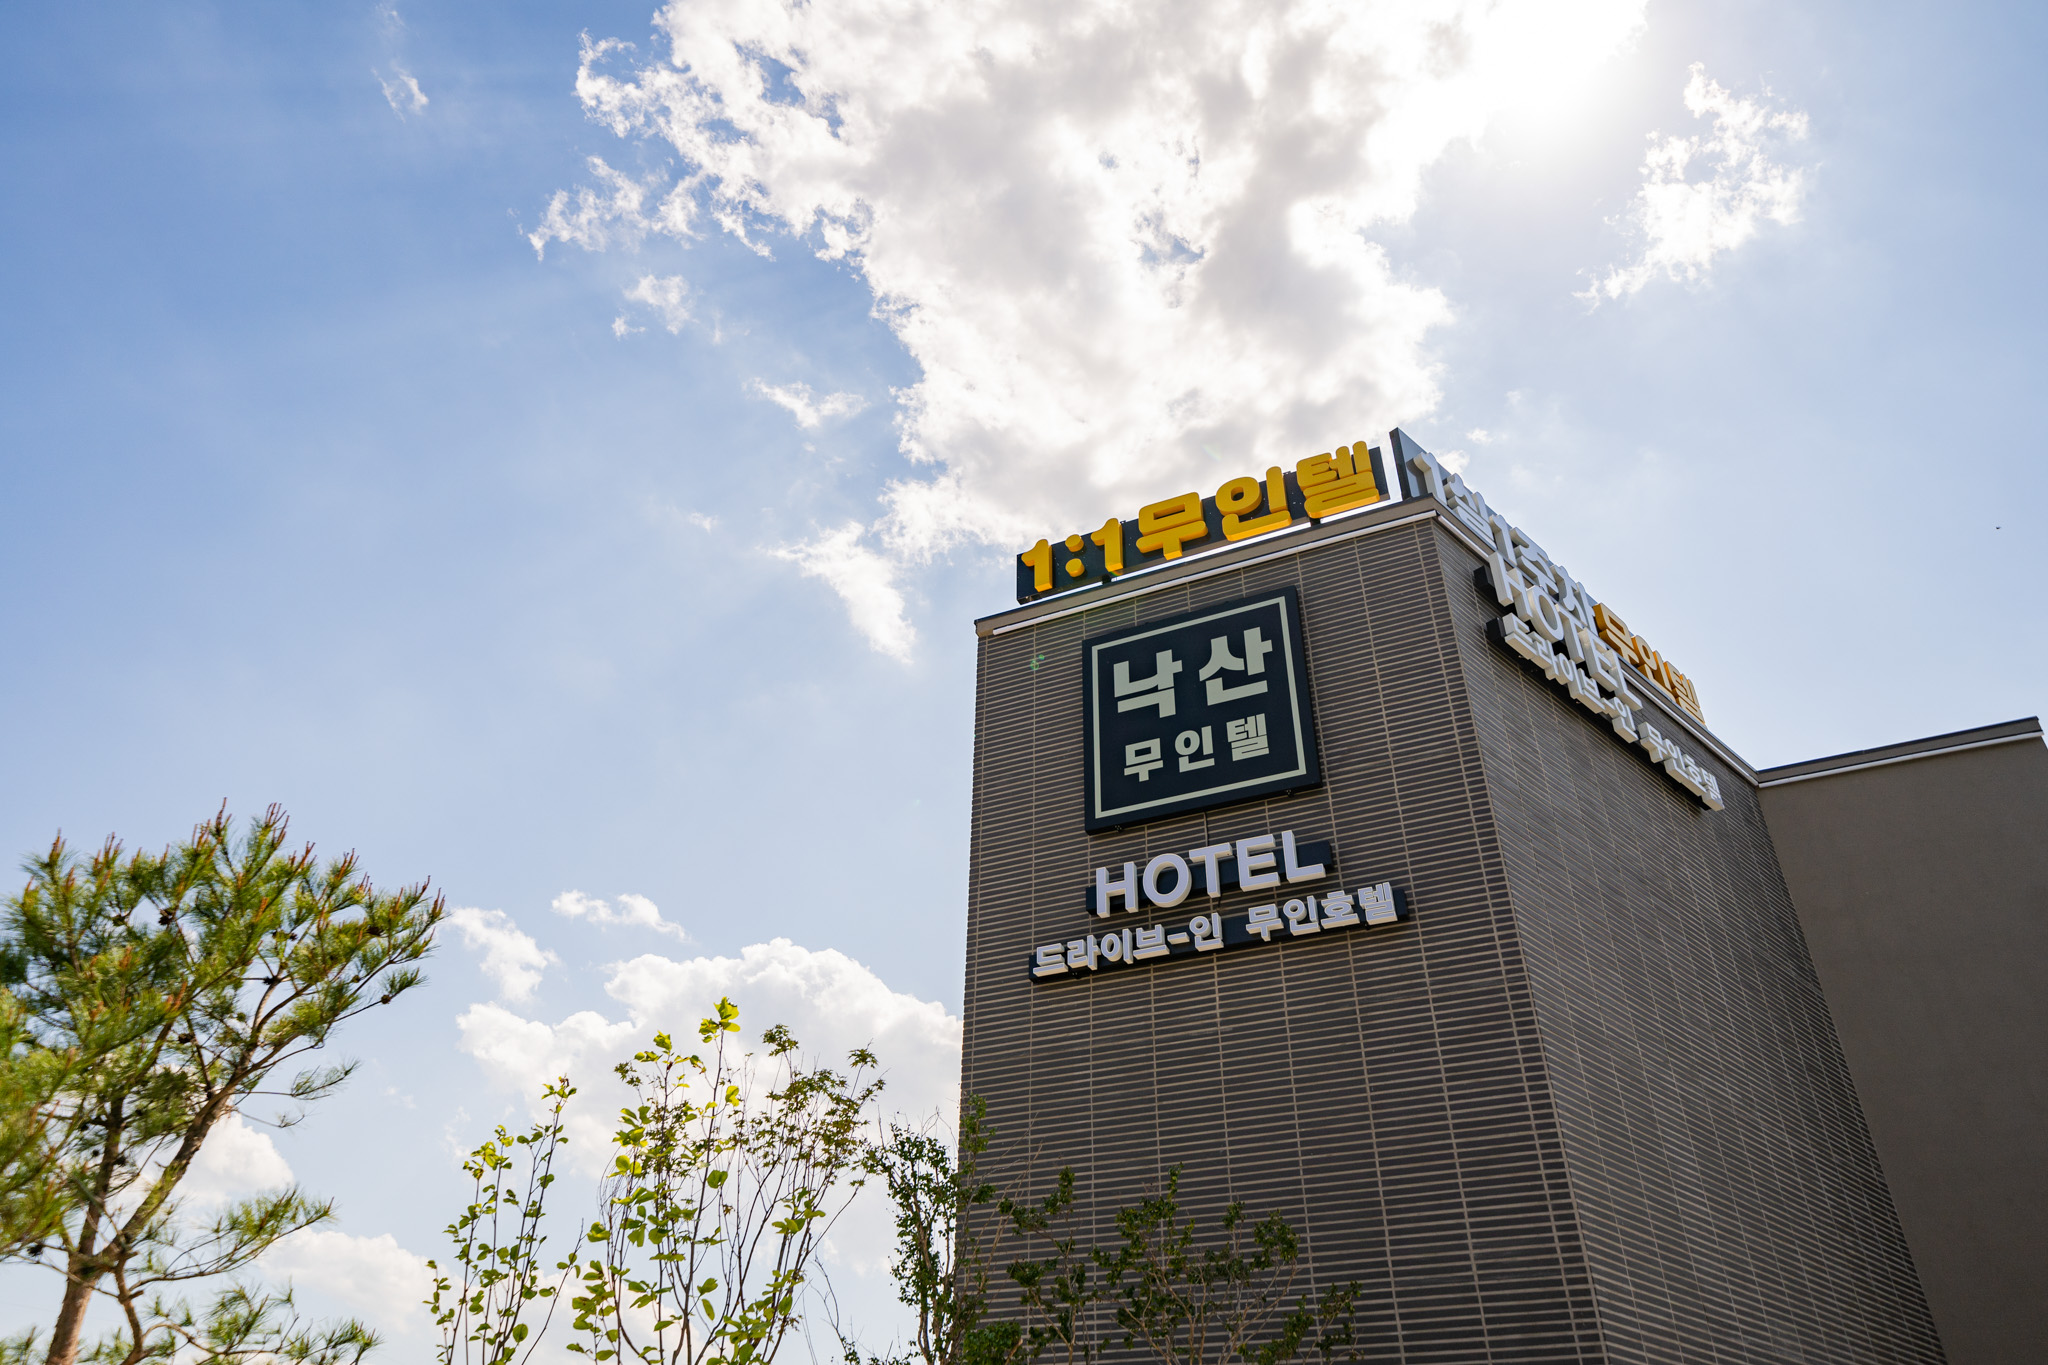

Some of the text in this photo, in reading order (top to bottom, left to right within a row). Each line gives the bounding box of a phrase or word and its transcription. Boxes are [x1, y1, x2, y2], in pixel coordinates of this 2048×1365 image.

[1113, 627, 1272, 718] 낙산
[1489, 552, 1642, 711] HOTEL
[1124, 713, 1269, 782] 무인텔
[1096, 830, 1326, 918] HOTEL
[1033, 882, 1398, 976] 드라이브-인 무인호텔
